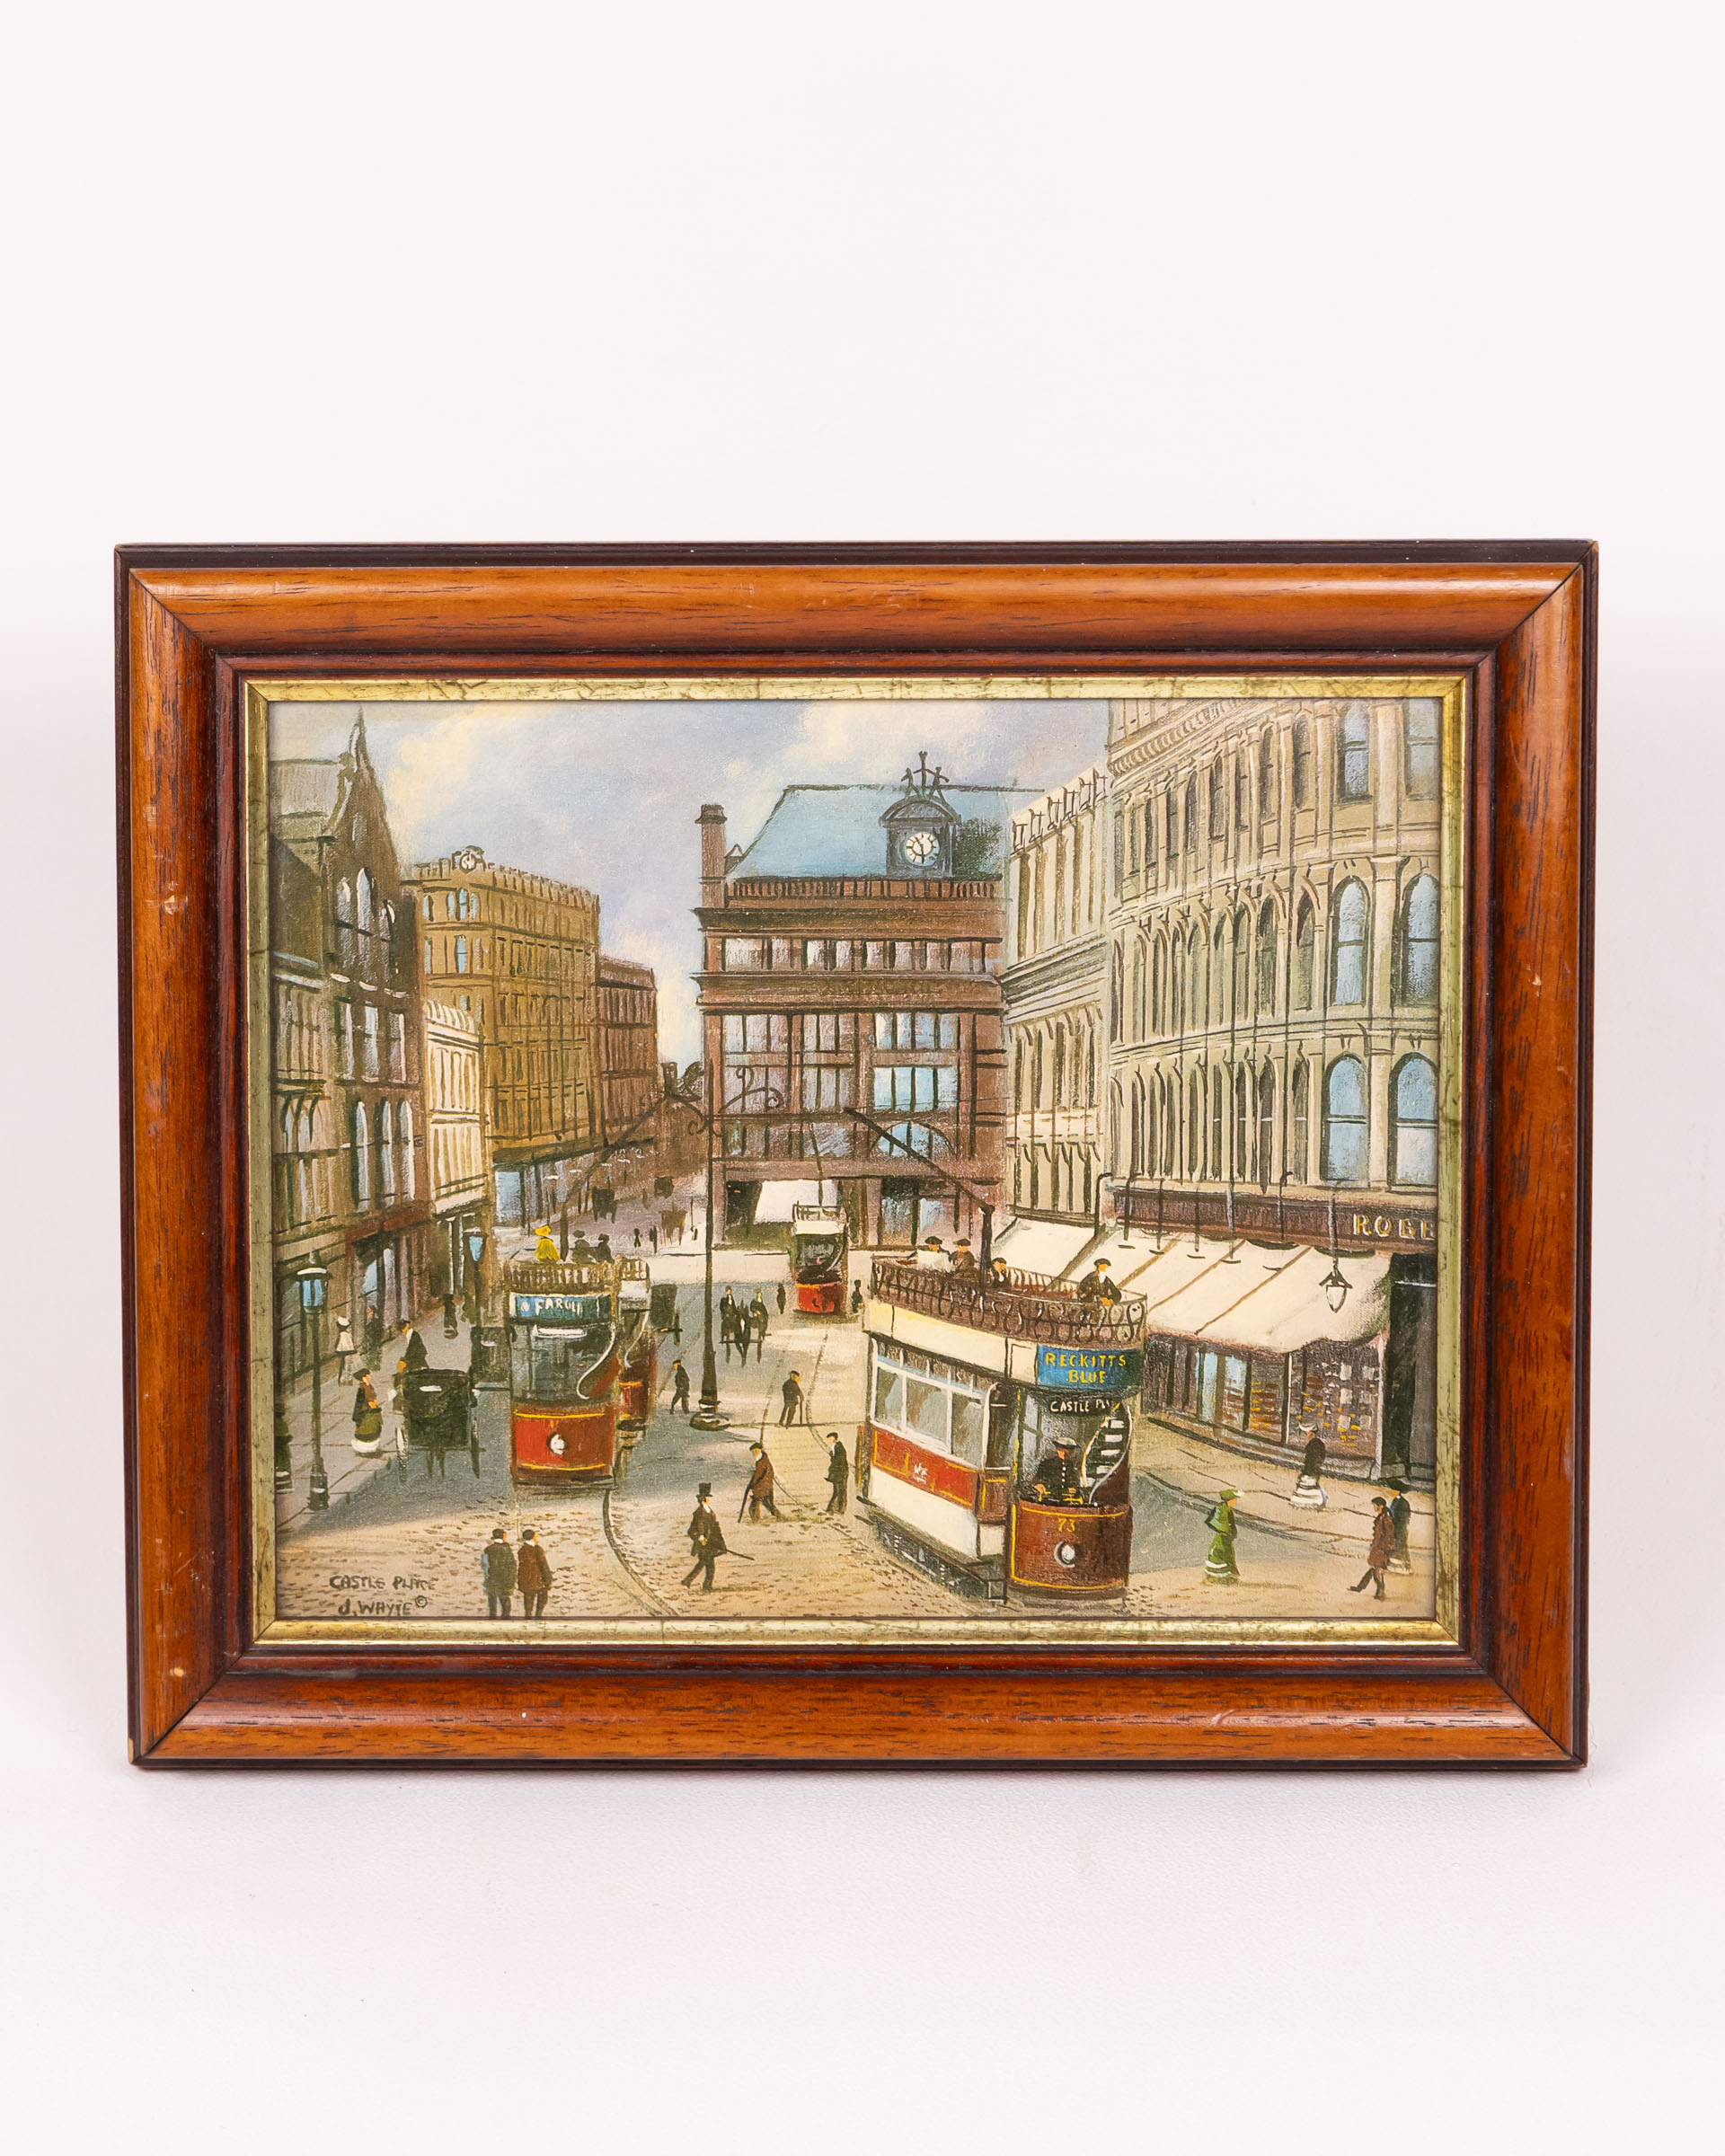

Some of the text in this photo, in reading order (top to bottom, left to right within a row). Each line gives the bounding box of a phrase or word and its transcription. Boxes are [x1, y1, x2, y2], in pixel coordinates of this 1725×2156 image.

[1045, 1352, 1127, 1368] RECKITTS
[1068, 1369, 1106, 1383] BLUE
[1049, 1401, 1090, 1413] CASTLE
[1057, 1517, 1075, 1533] 73
[329, 1575, 385, 1589] CASTLE
